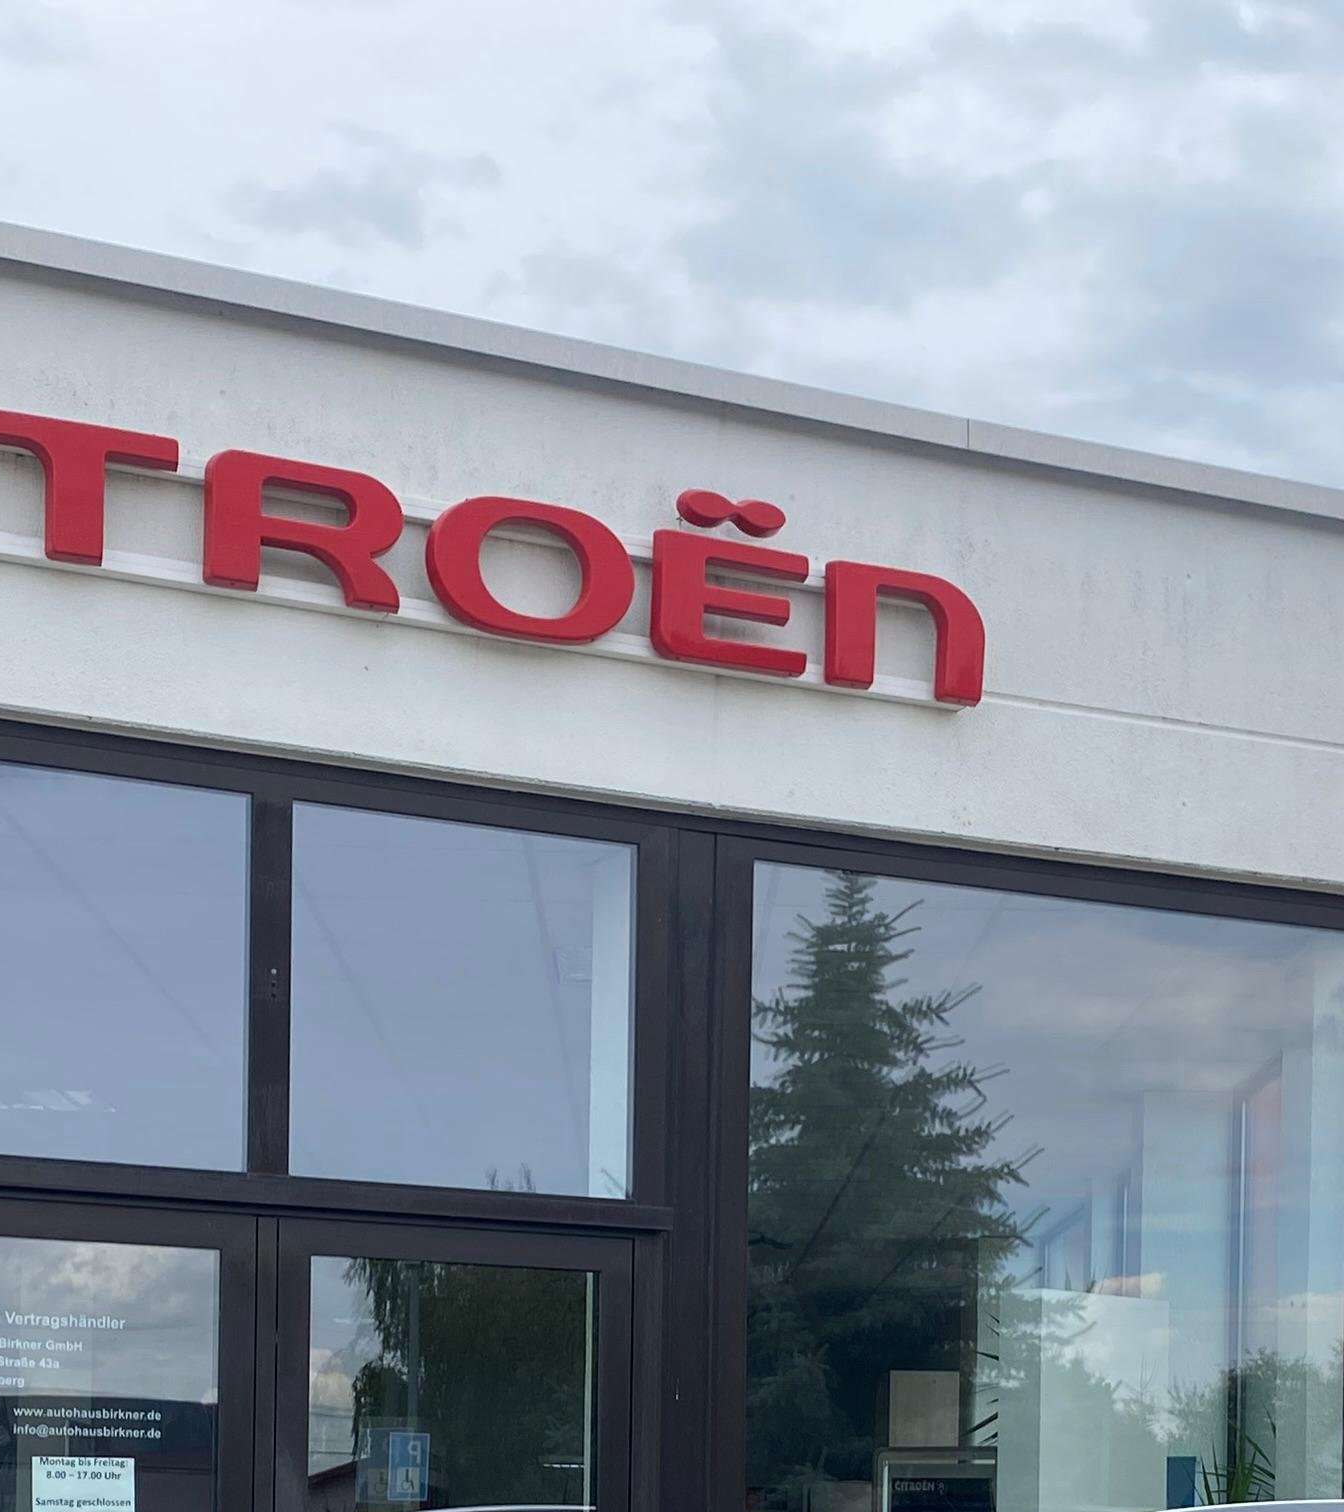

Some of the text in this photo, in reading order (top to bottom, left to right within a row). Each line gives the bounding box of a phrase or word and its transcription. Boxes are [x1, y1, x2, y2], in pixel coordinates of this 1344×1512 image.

[5, 1311, 127, 1330] Vertragshändler
[45, 1340, 83, 1352] GmbH
[13, 1407, 162, 1421] www.autohausbirkner.de
[13, 1424, 162, 1440] info@autohausbirkner.de
[39, 1457, 76, 1468] Montag
[78, 1457, 92, 1467] bis
[46, 1470, 67, 1480] 8.00
[77, 1471, 102, 1480] 17.00
[104, 1471, 122, 1480] Uhr
[35, 1497, 132, 1508] Samstag geschlossen
